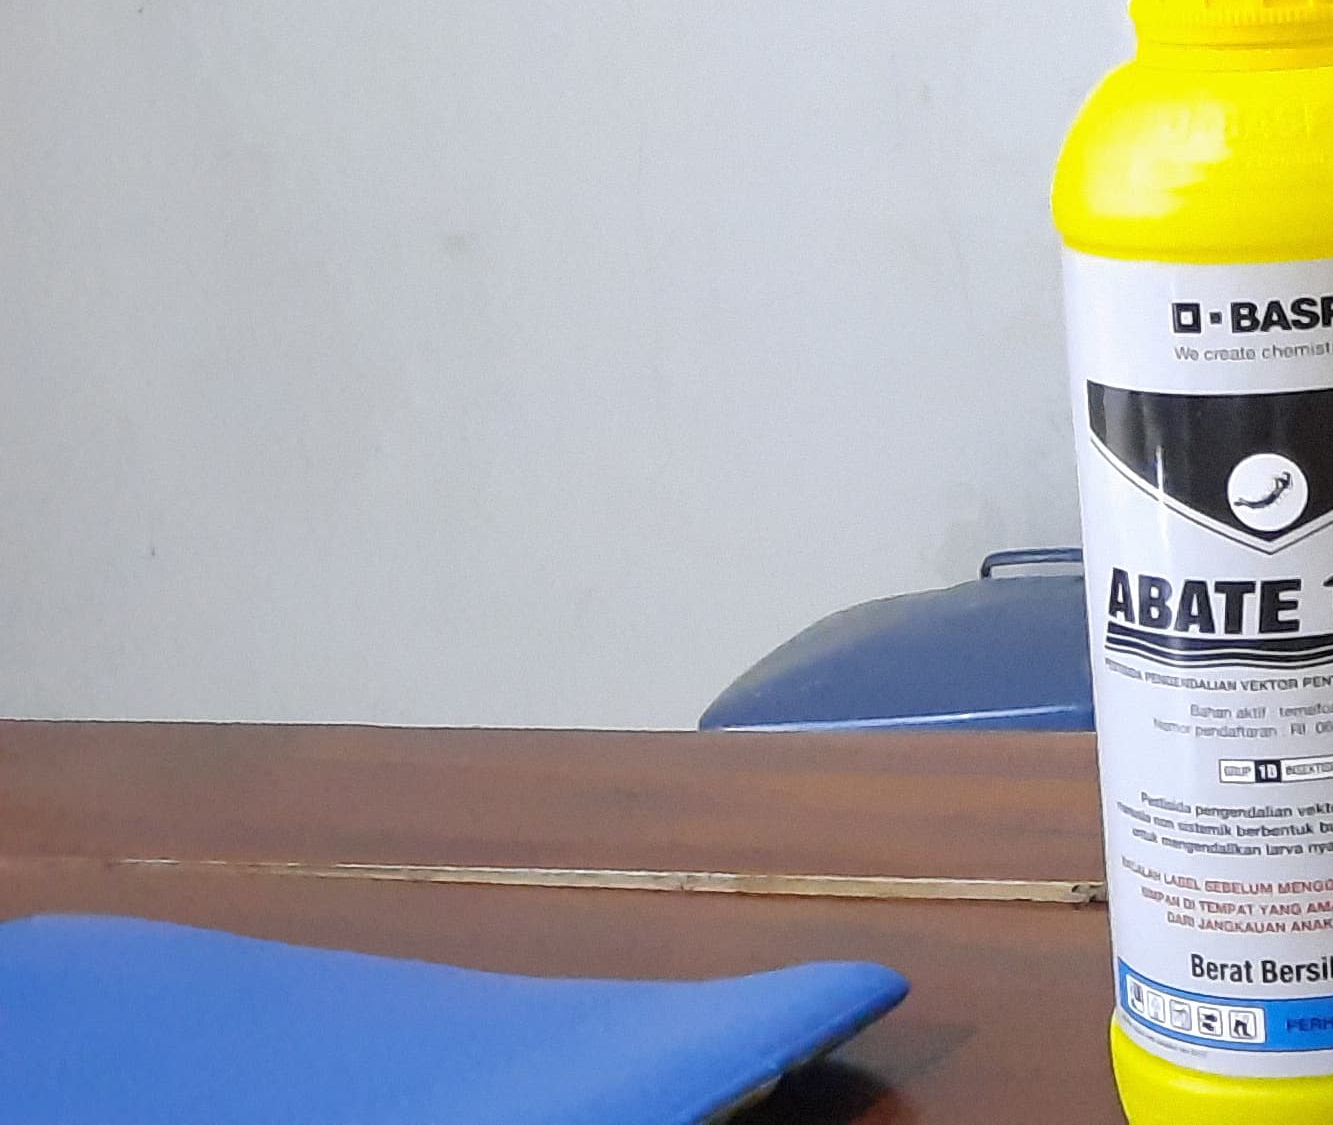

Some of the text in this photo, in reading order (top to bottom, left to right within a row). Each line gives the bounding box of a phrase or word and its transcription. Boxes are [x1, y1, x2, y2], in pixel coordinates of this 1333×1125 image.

[1174, 345, 1199, 361] We
[1203, 345, 1257, 362] create
[1107, 566, 1301, 634] ABATE
[1241, 678, 1299, 692] VEKTOR
[1195, 804, 1293, 820] pengendalian
[1236, 823, 1314, 838] berbentuk
[1266, 842, 1304, 856] larva
[1204, 880, 1273, 895] SEBELUM
[1199, 900, 1254, 915] TEMPAT
[1259, 903, 1302, 916] YANG
[1198, 918, 1286, 934] JANGKAUAN
[1291, 917, 1333, 933] ANAK
[1190, 952, 1254, 984] Berat
